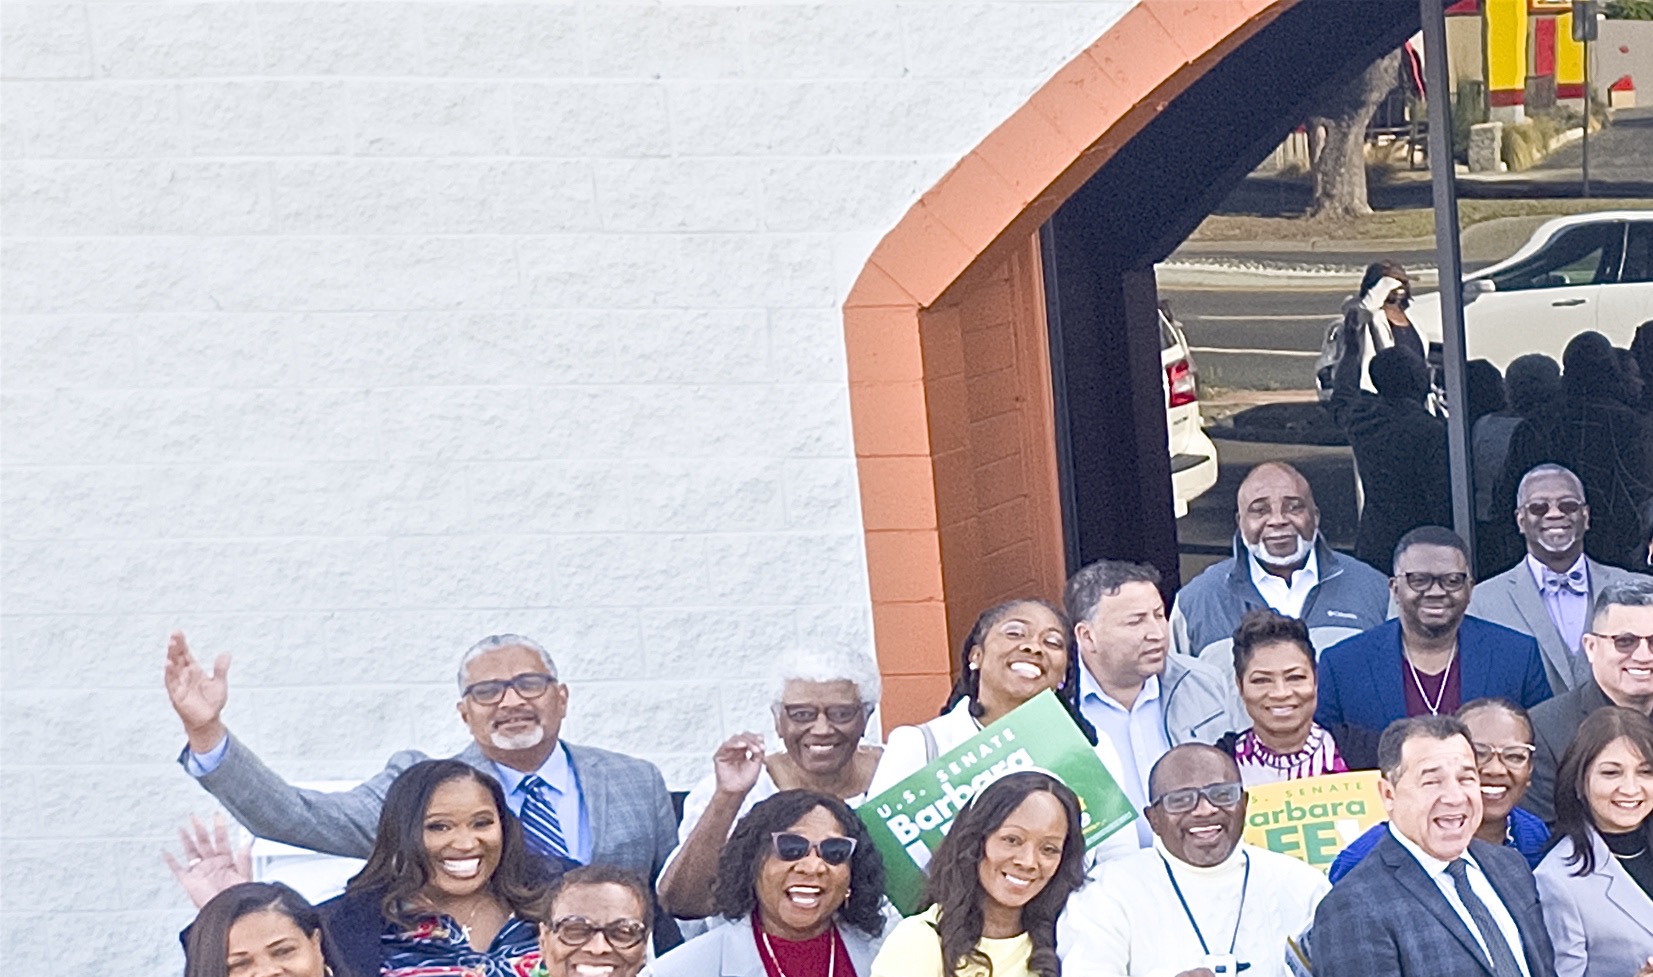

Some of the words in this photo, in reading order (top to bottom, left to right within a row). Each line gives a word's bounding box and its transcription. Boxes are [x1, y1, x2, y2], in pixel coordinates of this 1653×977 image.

[877, 787, 926, 818] U.S.
[936, 728, 1016, 782] SENATE
[1286, 782, 1363, 798] SENATE
[1250, 800, 1366, 827] arbara
[1265, 821, 1337, 864] EE
